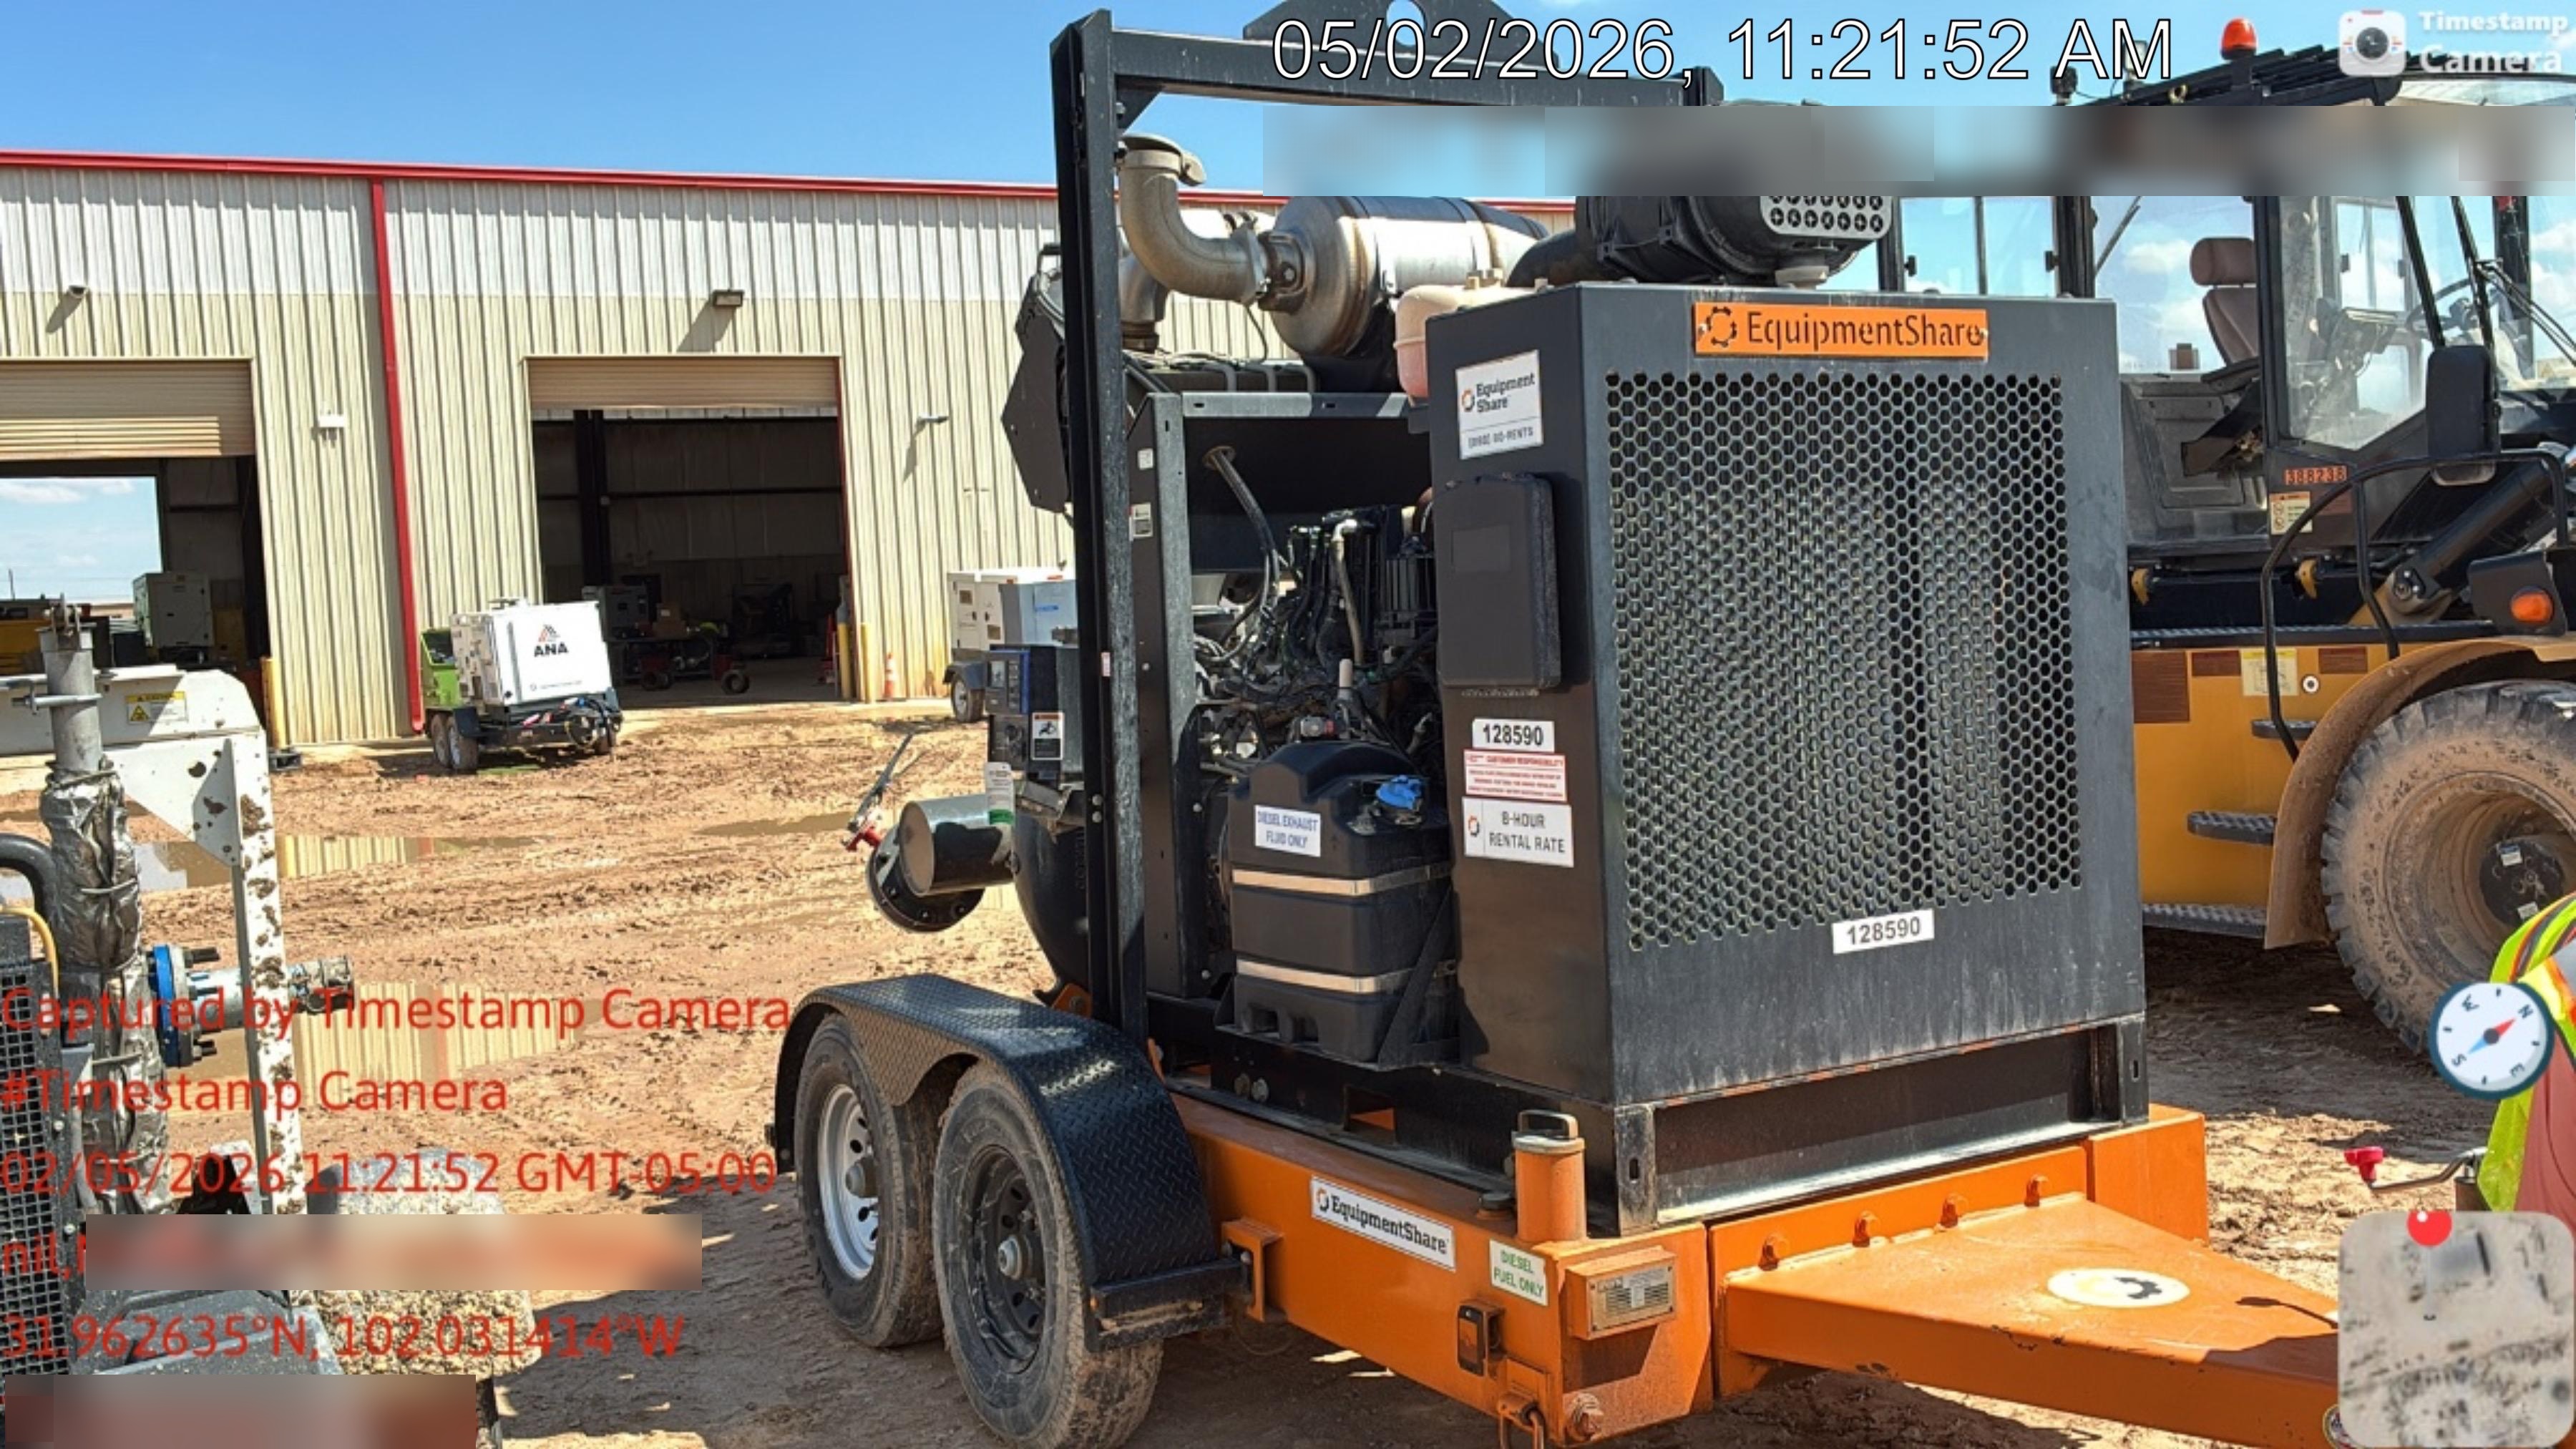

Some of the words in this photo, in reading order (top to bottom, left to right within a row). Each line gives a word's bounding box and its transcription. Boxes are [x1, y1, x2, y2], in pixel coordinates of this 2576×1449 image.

[1747, 311, 1986, 352] EquipmentShare
[1476, 372, 1536, 397] Equipment
[1476, 397, 1508, 413] Share
[533, 642, 570, 658] ANA
[1483, 723, 1544, 746] 128590
[1489, 832, 1531, 851] RENTAL
[1534, 836, 1566, 853] RATE
[1847, 916, 1921, 945] 128590
[1331, 1194, 1447, 1255] EquipmentShare
[1500, 1249, 1534, 1274] DIESEL
[1519, 1277, 1544, 1297] ONLY
